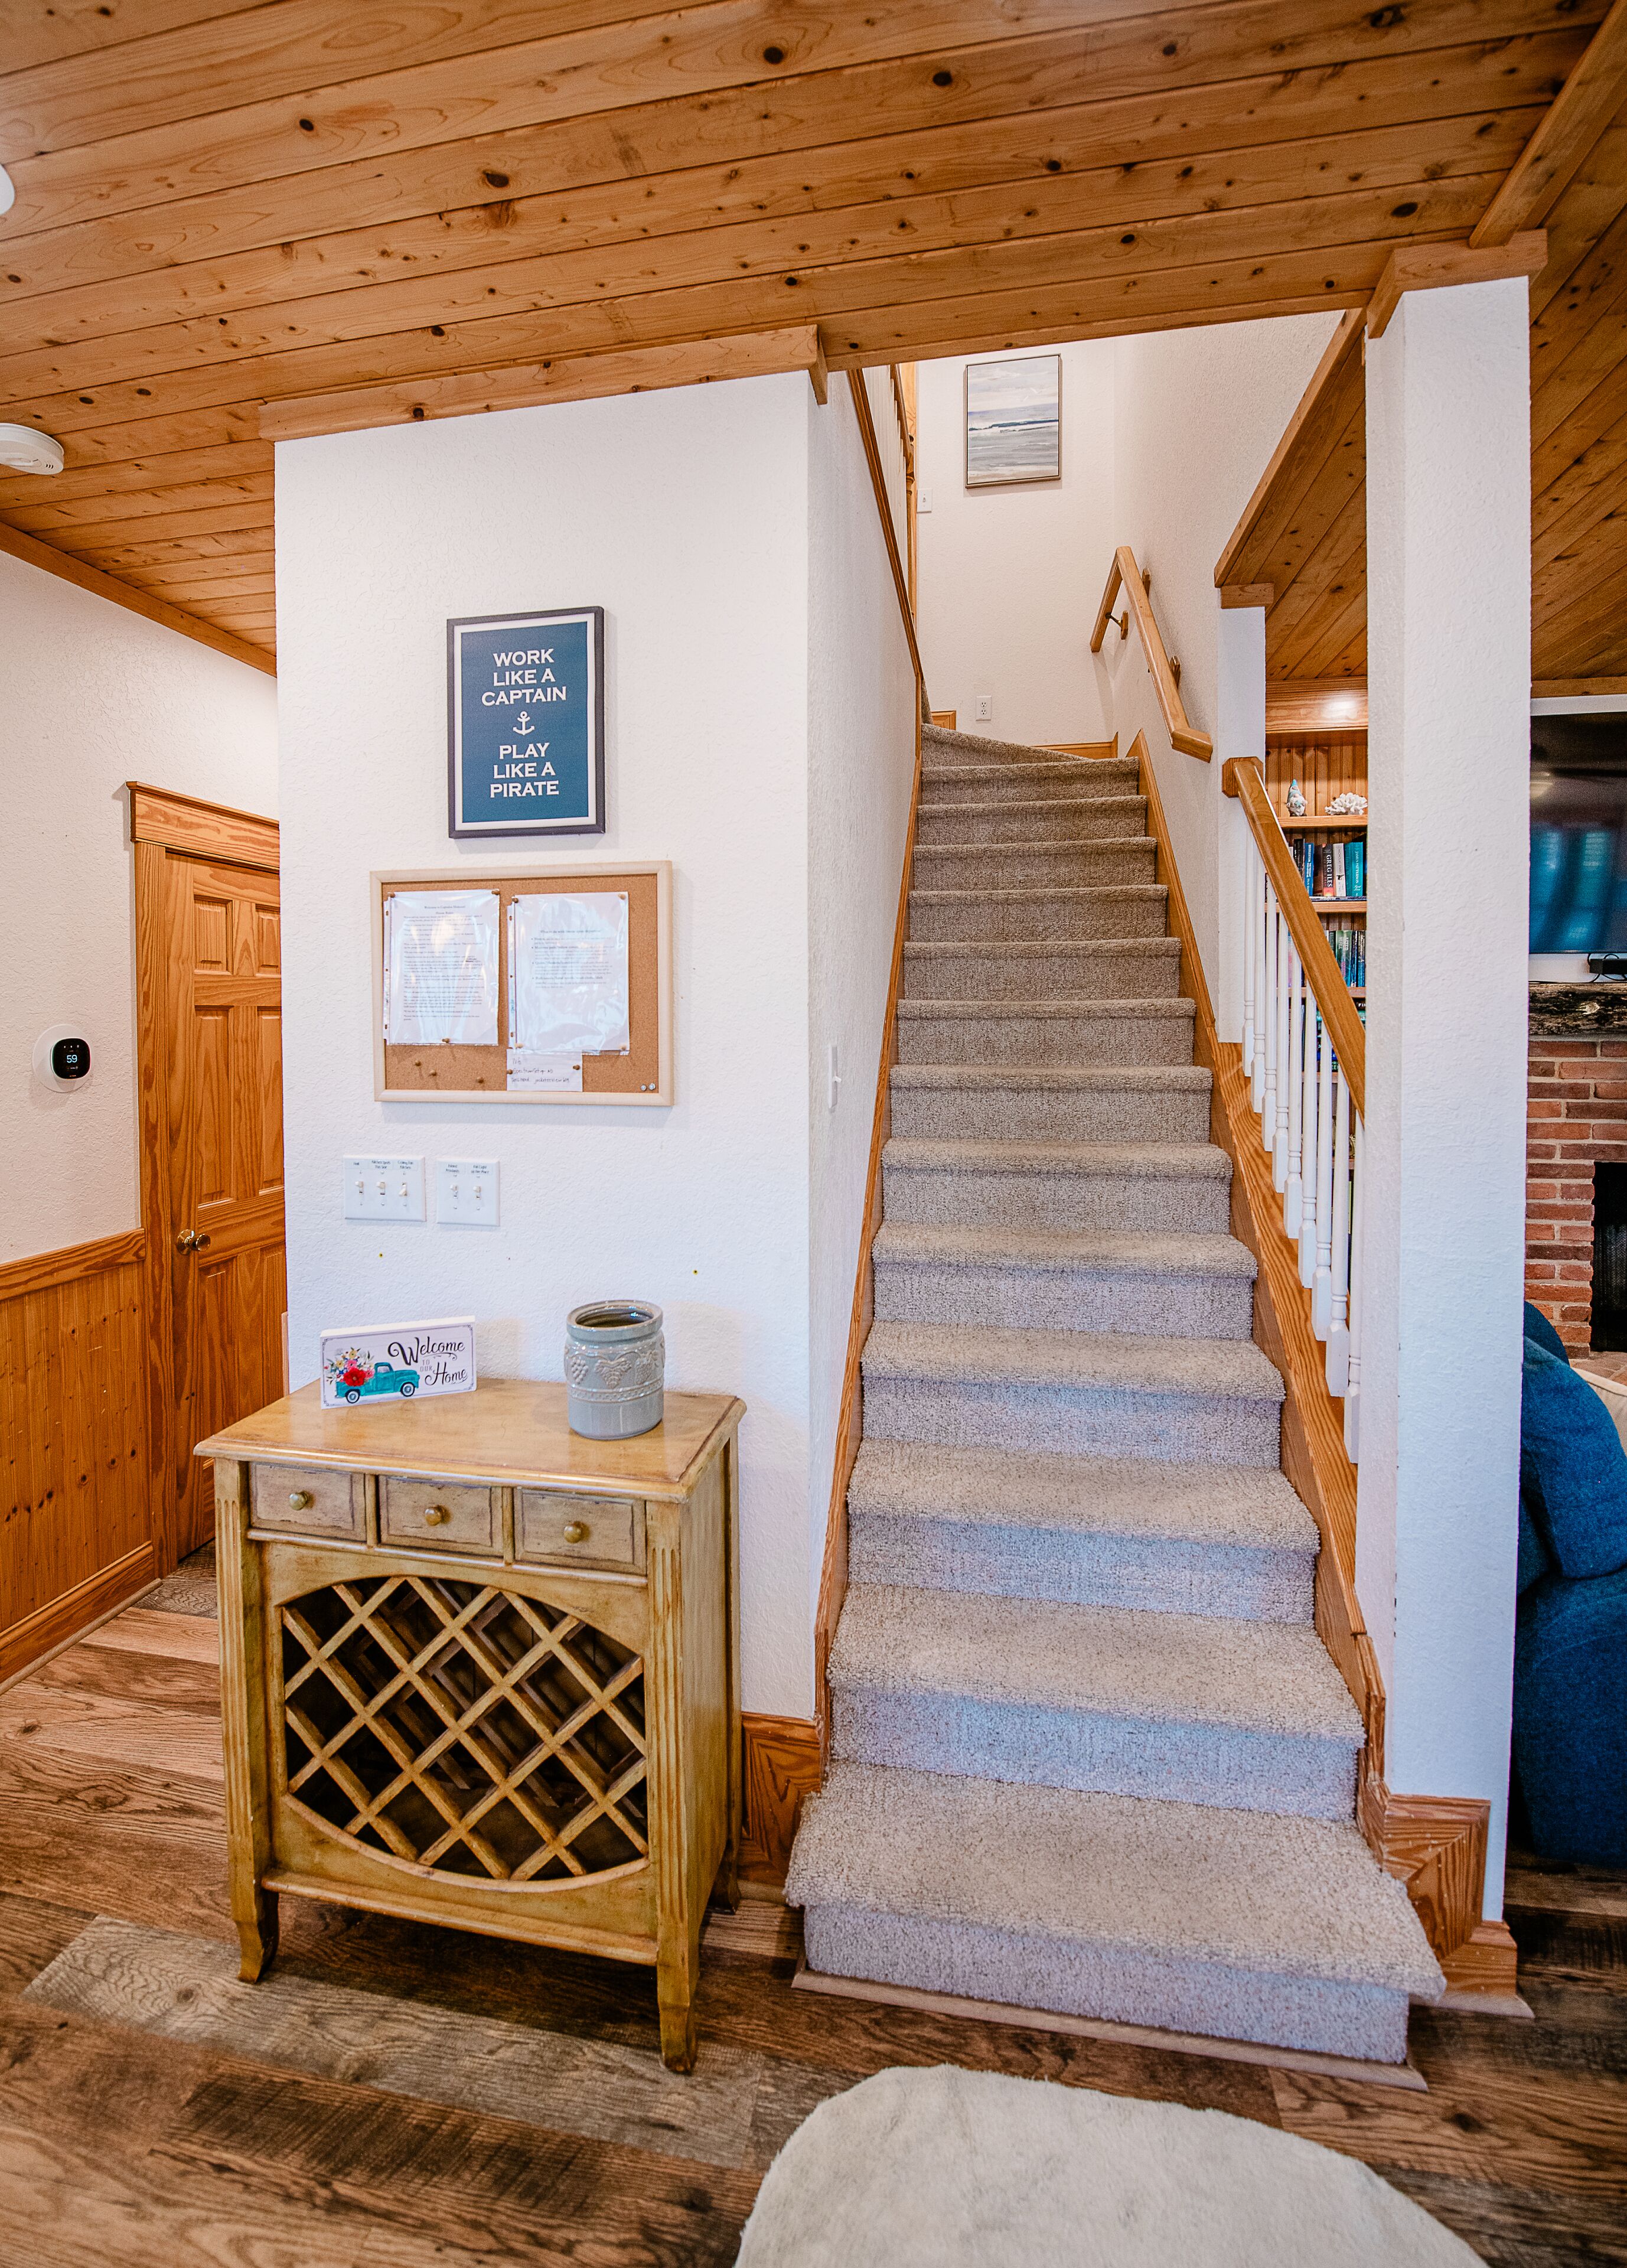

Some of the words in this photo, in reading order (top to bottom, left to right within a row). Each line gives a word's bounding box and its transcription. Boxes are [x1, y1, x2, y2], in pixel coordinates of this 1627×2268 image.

[493, 648, 555, 667] WORK
[493, 669, 537, 686] LIKE
[540, 667, 556, 683] A
[481, 686, 567, 706] CAPTAIN
[498, 742, 550, 760] PLAY
[493, 762, 537, 779] LIKE
[540, 761, 556, 777] A
[490, 780, 559, 799] PIRATE
[67, 1054, 77, 1063] 59
[387, 1336, 465, 1366] Welcome
[424, 1362, 468, 1386] Home
